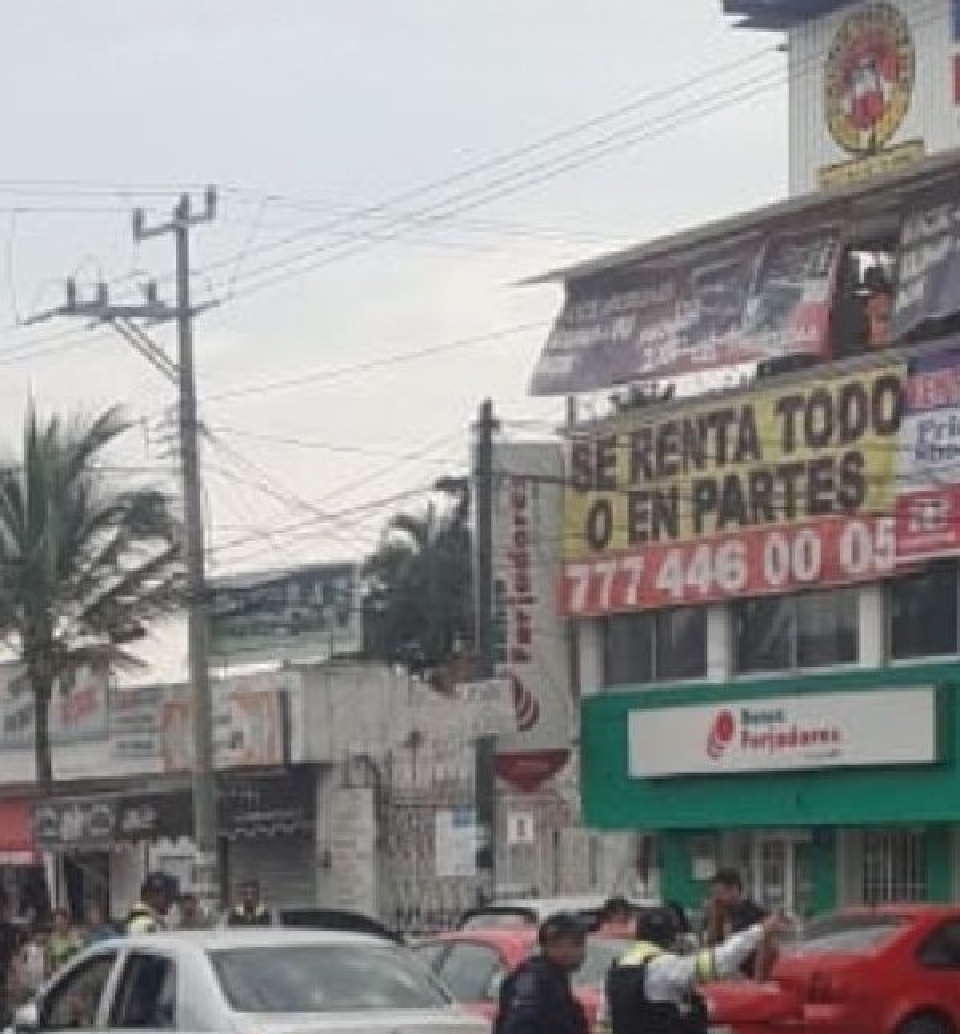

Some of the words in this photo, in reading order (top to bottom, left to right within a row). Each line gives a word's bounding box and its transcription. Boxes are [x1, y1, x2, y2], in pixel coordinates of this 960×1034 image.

[571, 434, 617, 490] SE
[628, 405, 760, 480] RENTA
[775, 376, 903, 454] TODO
[585, 498, 613, 551] O
[627, 487, 680, 544] EN
[693, 450, 866, 534] PARTES
[563, 557, 644, 612] 777
[655, 542, 749, 599] 446
[763, 529, 823, 587] 00
[839, 518, 898, 576] 05
